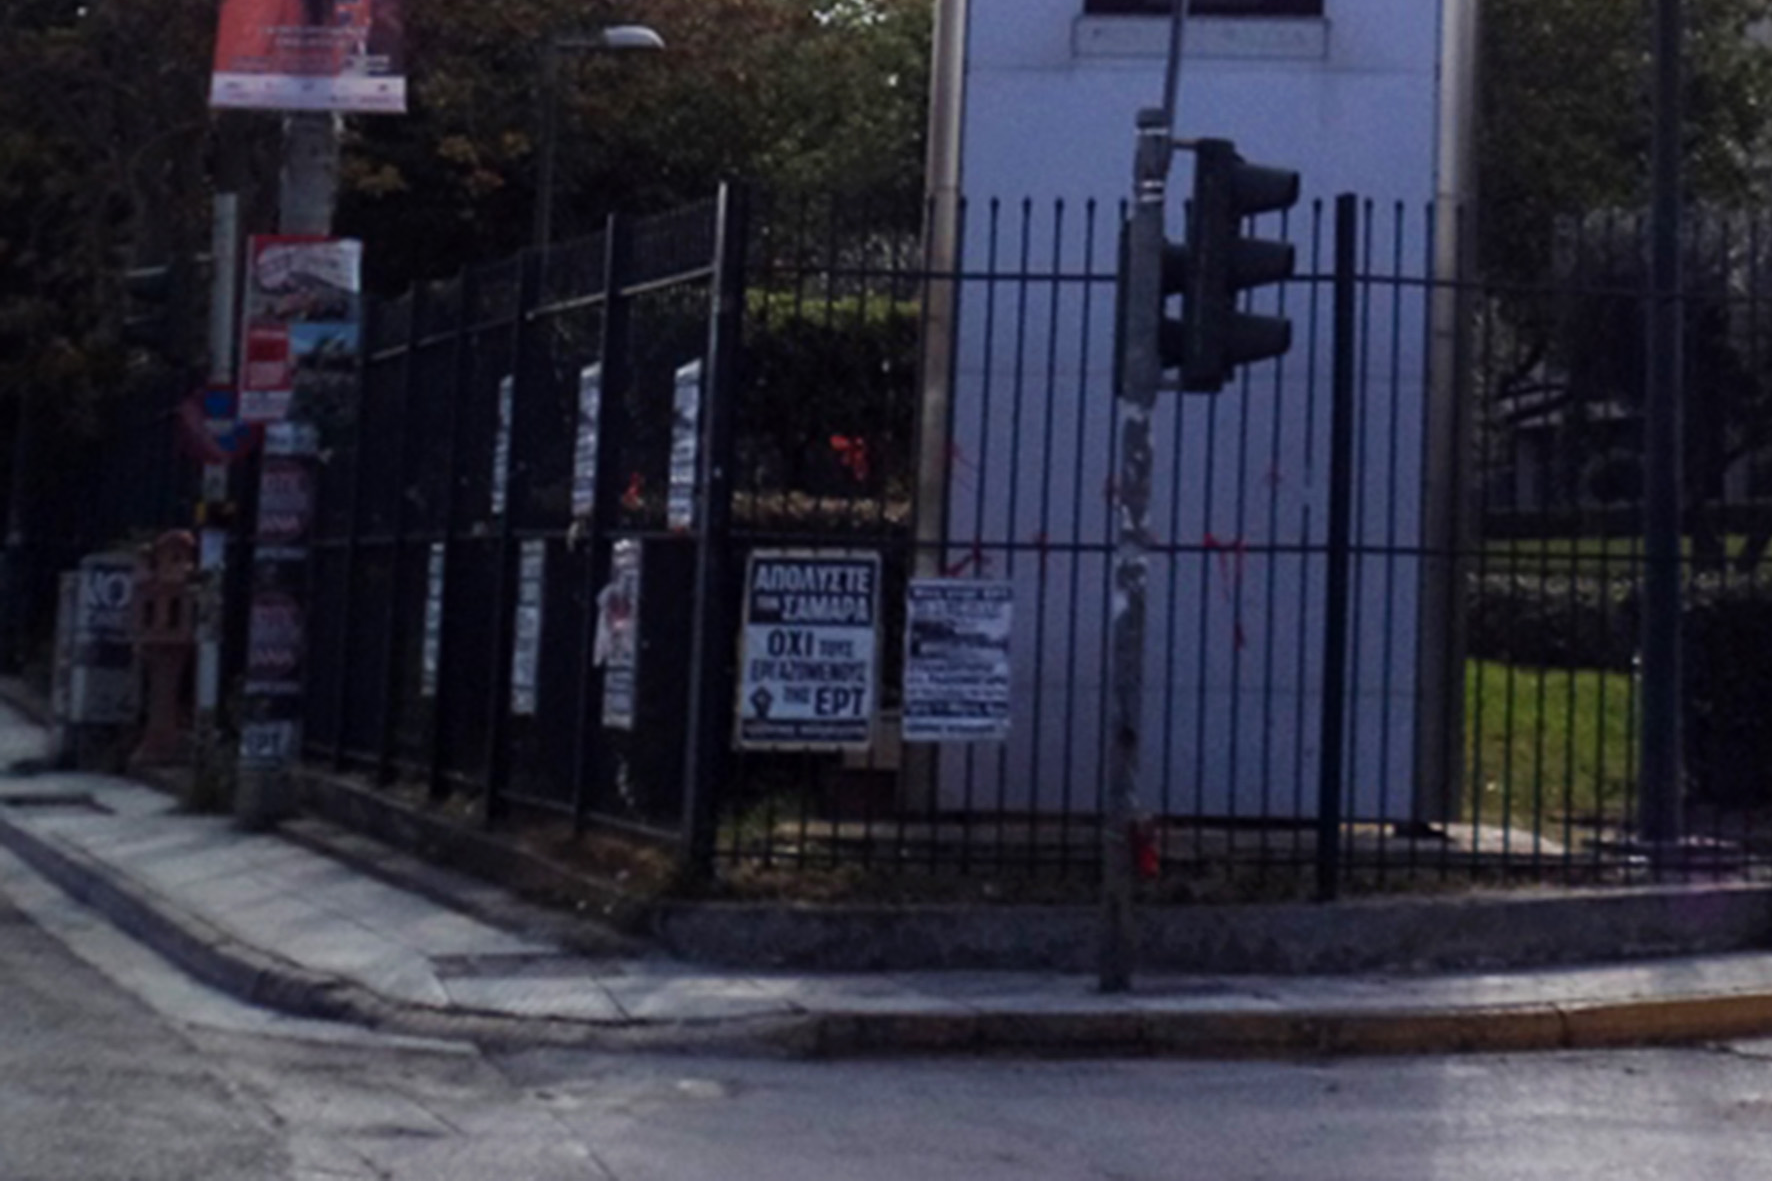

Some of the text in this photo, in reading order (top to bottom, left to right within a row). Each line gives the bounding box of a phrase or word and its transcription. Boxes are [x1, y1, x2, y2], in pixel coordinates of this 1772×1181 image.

[754, 564, 870, 592] ΑΠΟΛΥΣΤΕ
[781, 594, 869, 622] ΣΑΜΑΡΑ
[767, 629, 814, 657] ΟΧΙ
[815, 687, 865, 716] ΕΡΤ
